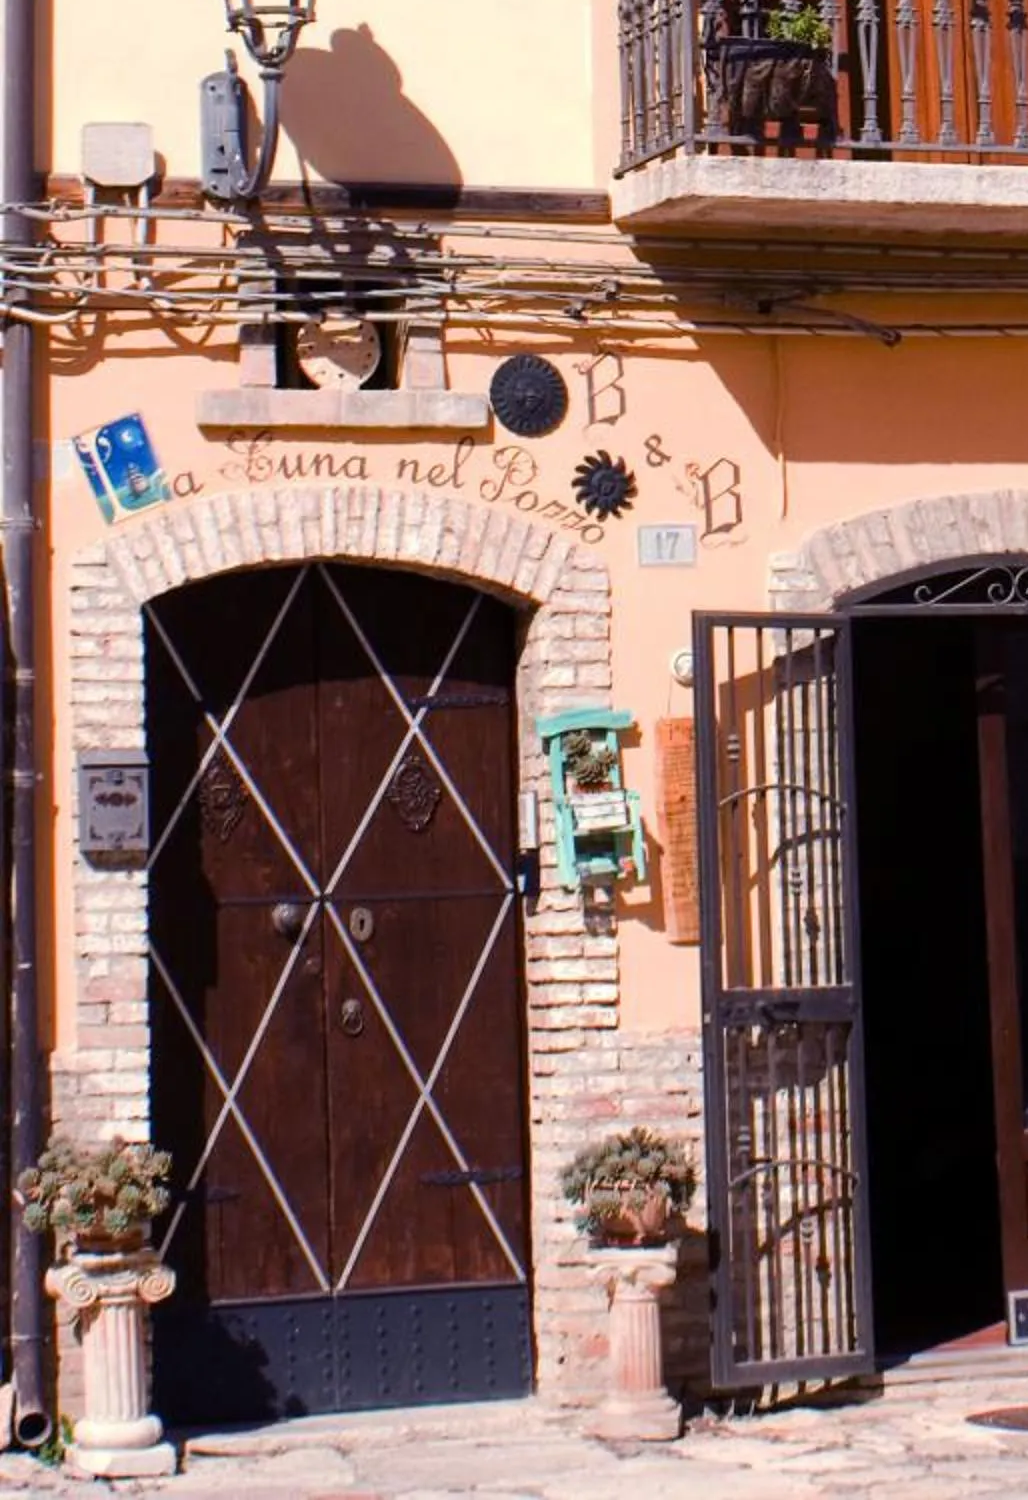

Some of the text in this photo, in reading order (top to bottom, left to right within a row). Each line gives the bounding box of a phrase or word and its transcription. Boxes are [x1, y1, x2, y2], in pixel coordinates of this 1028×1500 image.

[219, 429, 370, 484] Luna
[397, 435, 475, 489] nel
[479, 446, 604, 544] Pozzo
[573, 351, 743, 544] B & B
[656, 531, 680, 560] 17
